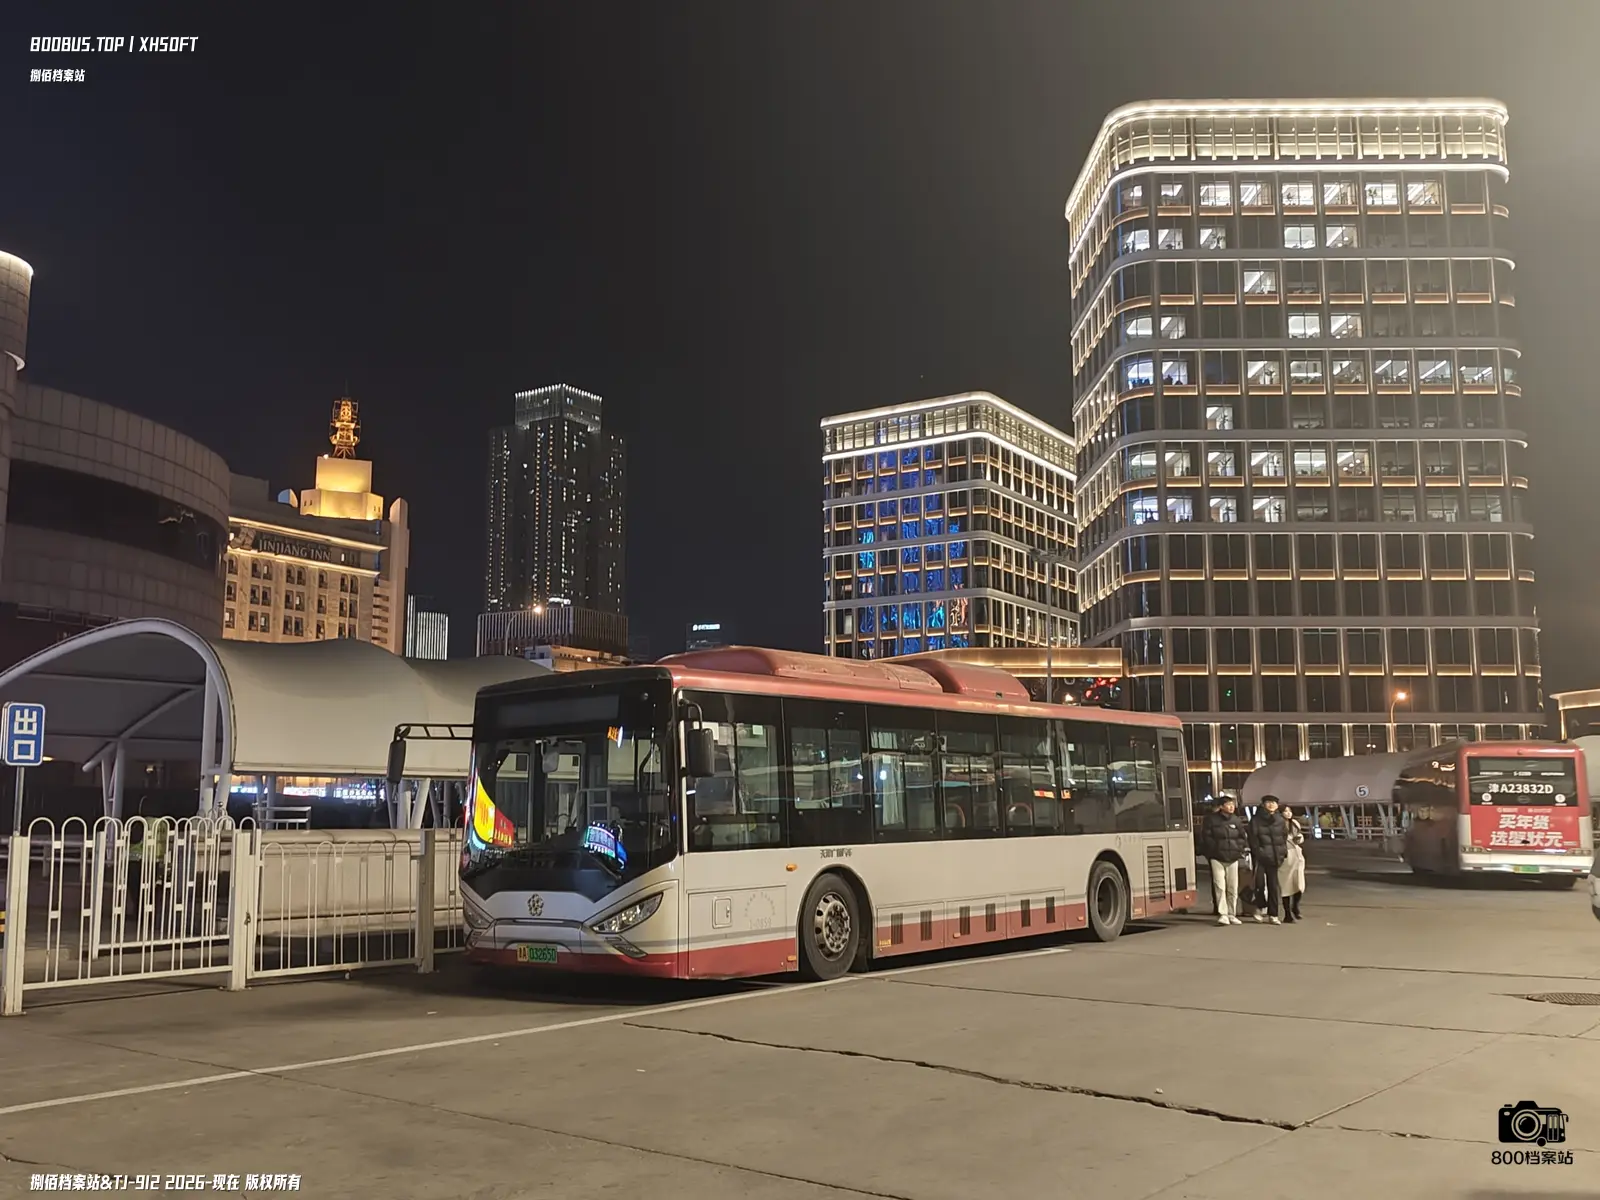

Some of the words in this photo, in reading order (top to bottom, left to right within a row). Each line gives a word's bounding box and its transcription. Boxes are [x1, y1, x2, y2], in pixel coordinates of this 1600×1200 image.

[258, 538, 309, 558] JINJIANG
[310, 548, 332, 562] INN
[13, 708, 38, 761] 出口
[1358, 786, 1367, 796] 5
[1498, 813, 1550, 830] 买年货
